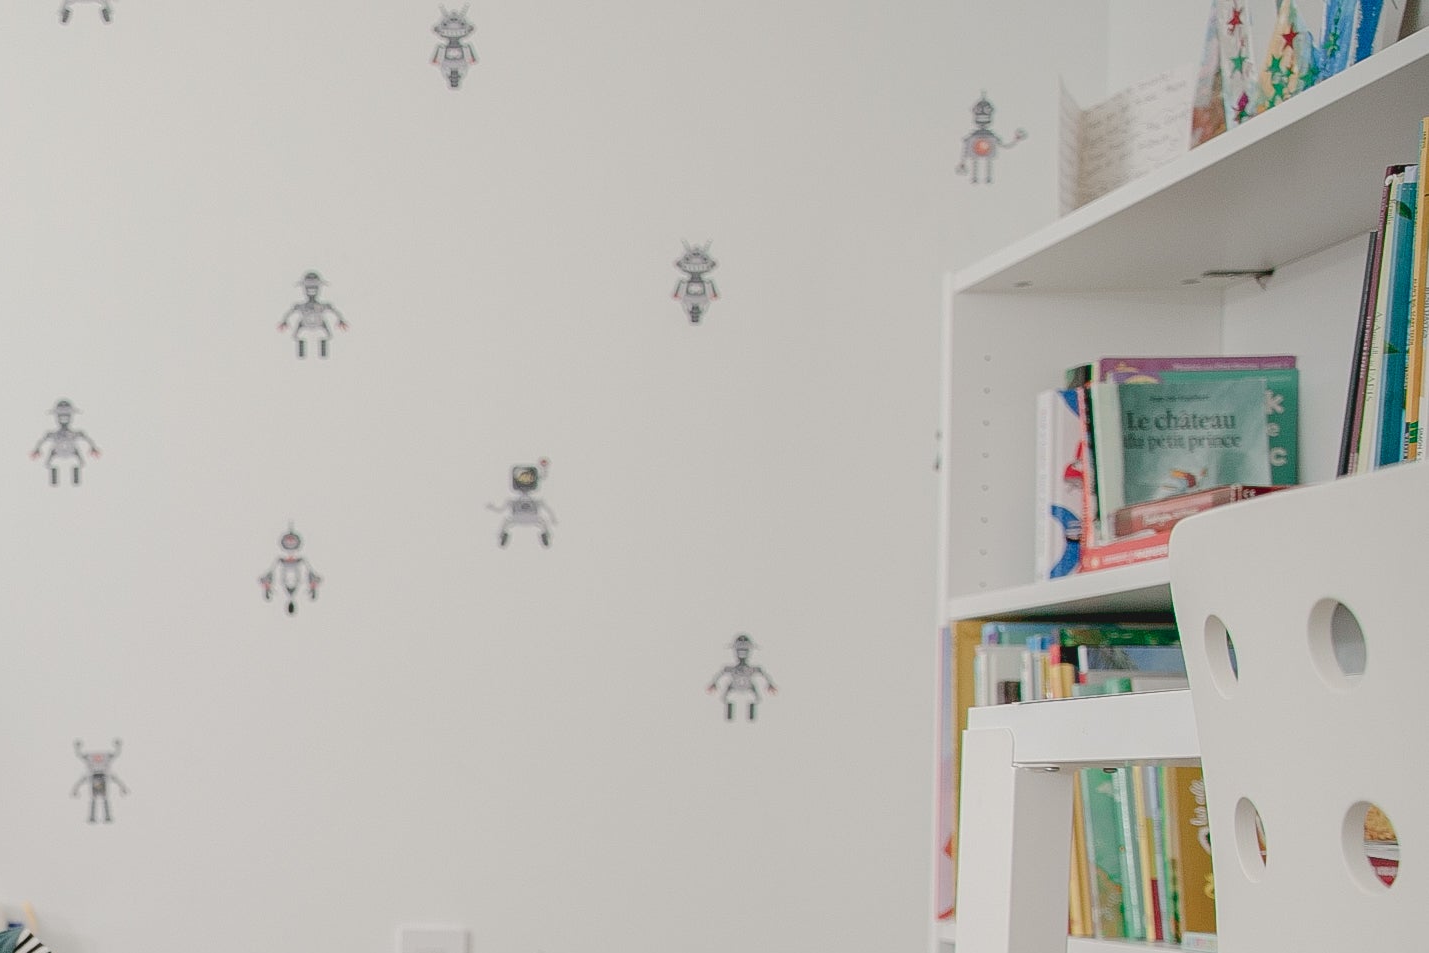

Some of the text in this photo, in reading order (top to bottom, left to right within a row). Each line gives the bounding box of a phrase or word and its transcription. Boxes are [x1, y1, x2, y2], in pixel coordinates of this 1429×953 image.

[1125, 408, 1236, 431] Le château
[1147, 434, 1185, 452] petit
[1188, 433, 1243, 453] prince
